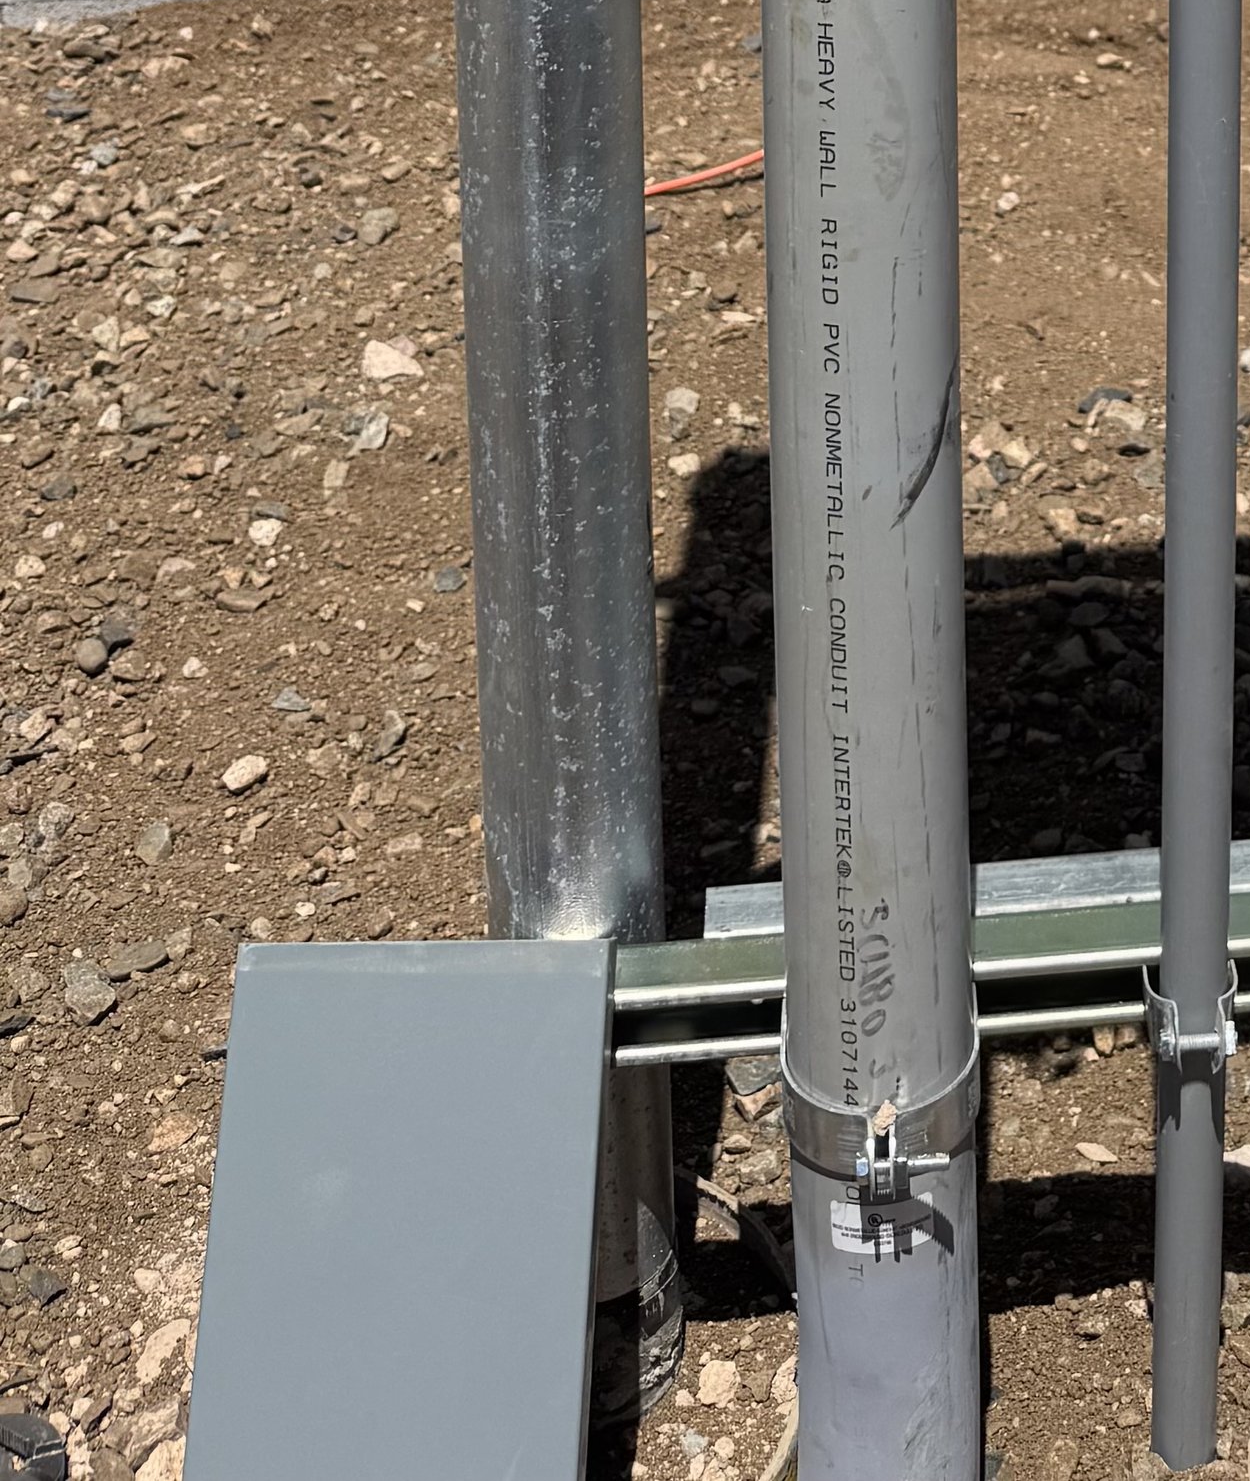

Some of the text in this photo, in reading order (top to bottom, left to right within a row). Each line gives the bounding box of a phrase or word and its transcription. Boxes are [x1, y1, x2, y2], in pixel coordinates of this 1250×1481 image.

[817, 22, 836, 110] HEAVY
[819, 131, 837, 198] WALL
[821, 218, 839, 305] RIGID
[823, 323, 840, 375] PVC
[824, 393, 845, 581] NONMETALLIC
[829, 598, 848, 713] CONDUIT
[833, 734, 852, 859] INTERTEK
[837, 885, 856, 982] LISTED
[840, 999, 860, 1106] 3107144
